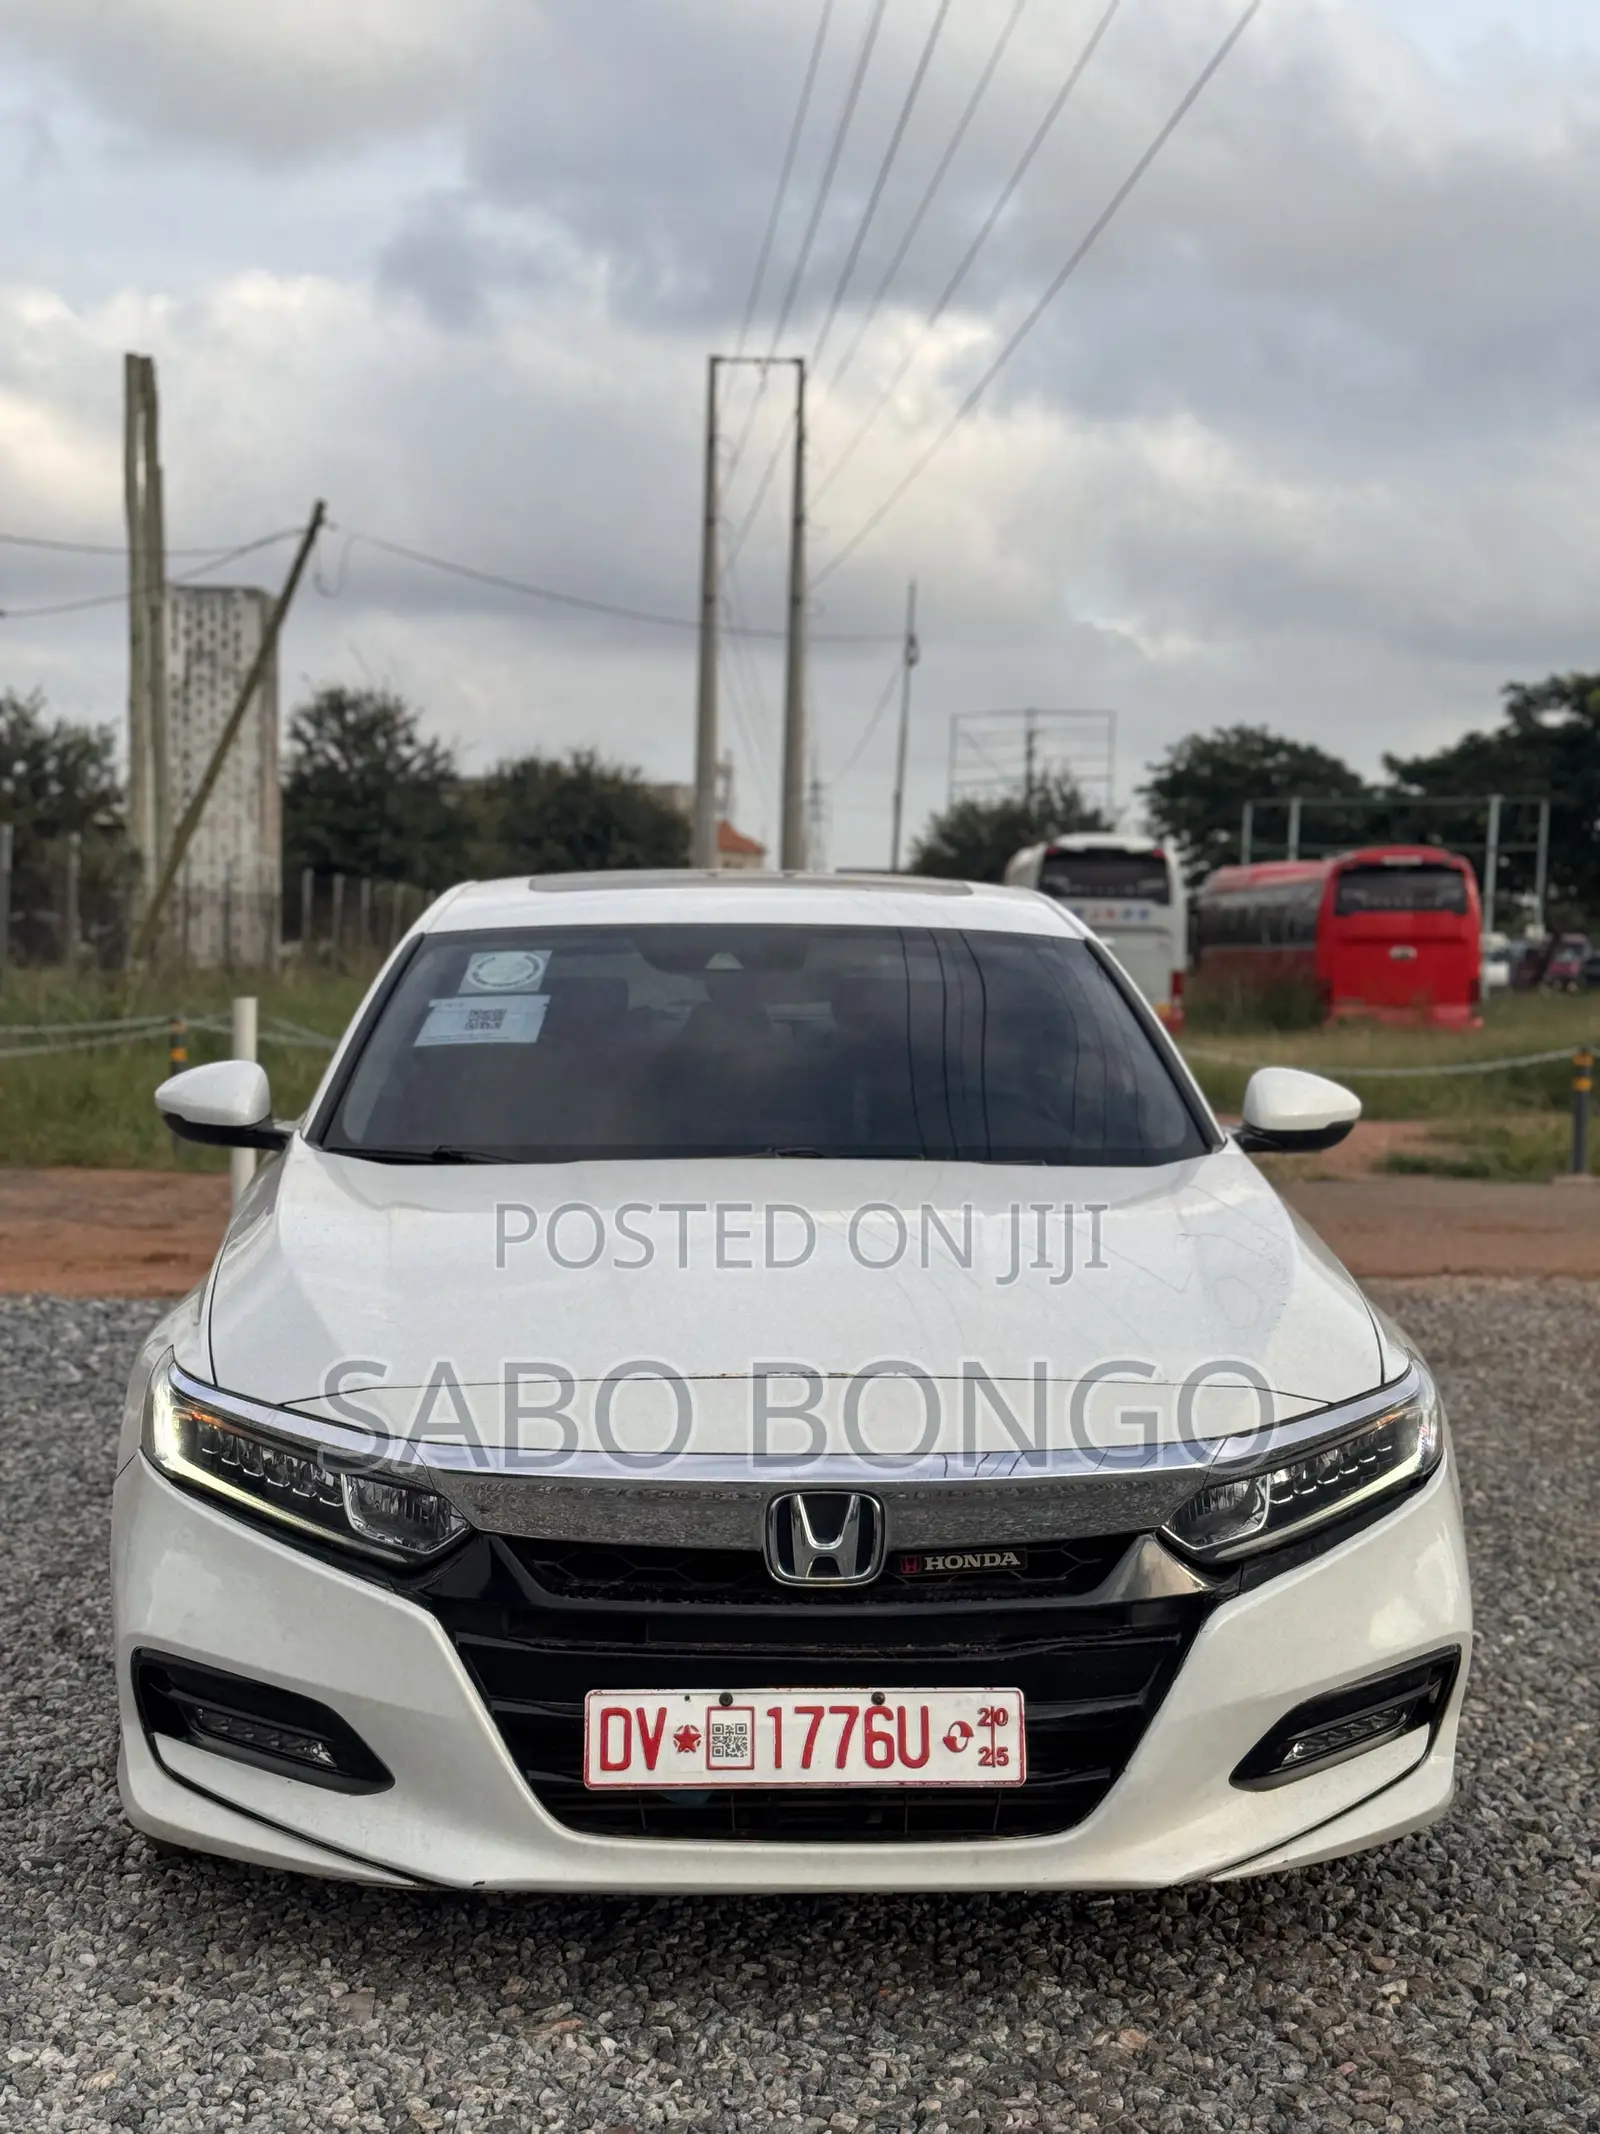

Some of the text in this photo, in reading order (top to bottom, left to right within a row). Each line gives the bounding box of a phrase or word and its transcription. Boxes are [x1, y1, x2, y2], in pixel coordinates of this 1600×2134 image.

[924, 1551, 1021, 1571] HONDA
[977, 1707, 1009, 1727] 20
[600, 1705, 930, 1772] DV 1776U
[977, 1746, 1010, 1767] 25
